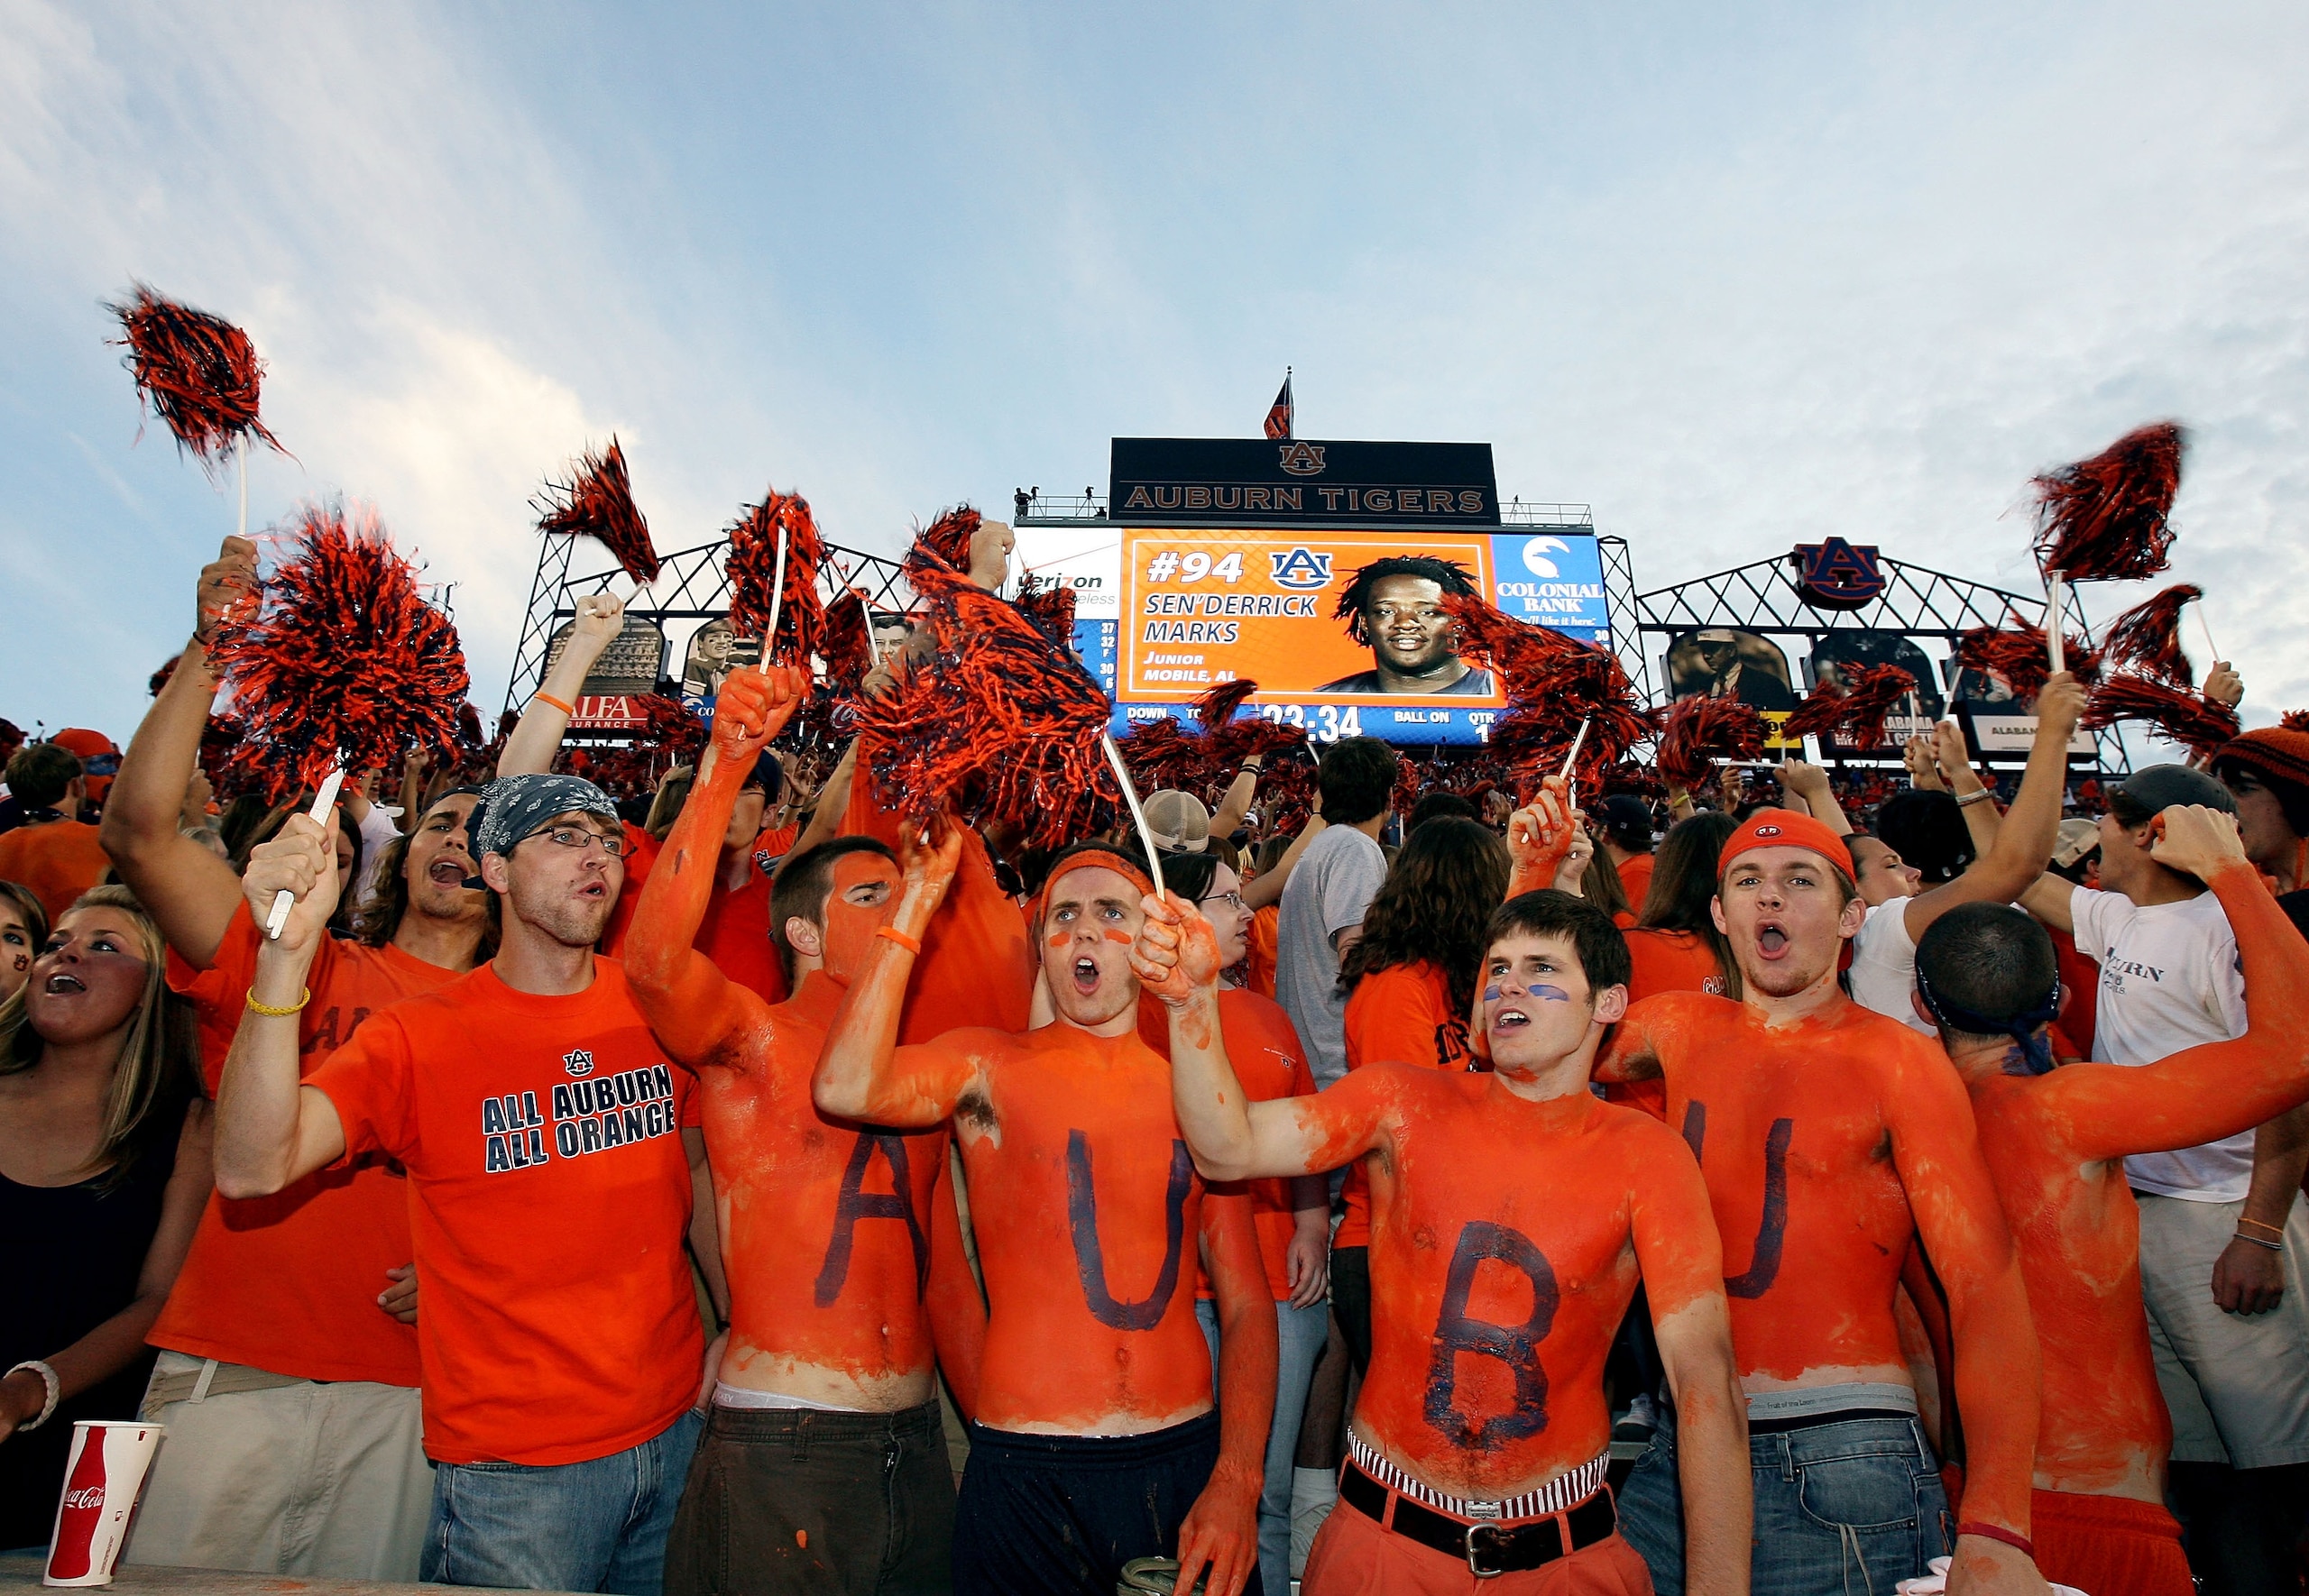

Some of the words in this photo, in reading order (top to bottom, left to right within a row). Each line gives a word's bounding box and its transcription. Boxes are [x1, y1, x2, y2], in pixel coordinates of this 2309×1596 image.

[1125, 486, 1302, 511] AUBURN
[1319, 488, 1484, 514] TIGERS
[1147, 551, 1244, 583] #94
[1496, 582, 1605, 599] COLONIAL
[1144, 592, 1319, 617] SEN'DERRICK
[1522, 597, 1583, 613] BANK
[1101, 622, 1115, 634] 37
[1541, 615, 1559, 626] like
[1560, 617, 1569, 626] it
[1143, 621, 1240, 644] MARKS
[1595, 629, 1609, 642] 30
[1100, 636, 1115, 647] 32
[1099, 663, 1115, 675] 30
[1143, 670, 1211, 683] MOBILE,
[1215, 670, 1237, 683] AL
[1105, 677, 1114, 690] 6
[1127, 707, 1168, 720] DOWN
[1394, 711, 1428, 723] BALL
[1430, 711, 1450, 723] ON
[1467, 712, 1496, 726] QTR
[1475, 724, 1490, 743] 1
[483, 1091, 545, 1136] ALL
[552, 1063, 675, 1122] AUBURN
[485, 1128, 550, 1173] ALL
[555, 1097, 675, 1160] ORANGE
[814, 1126, 928, 1308] A
[1067, 1127, 1194, 1332] U
[1422, 1220, 1560, 1450] B
